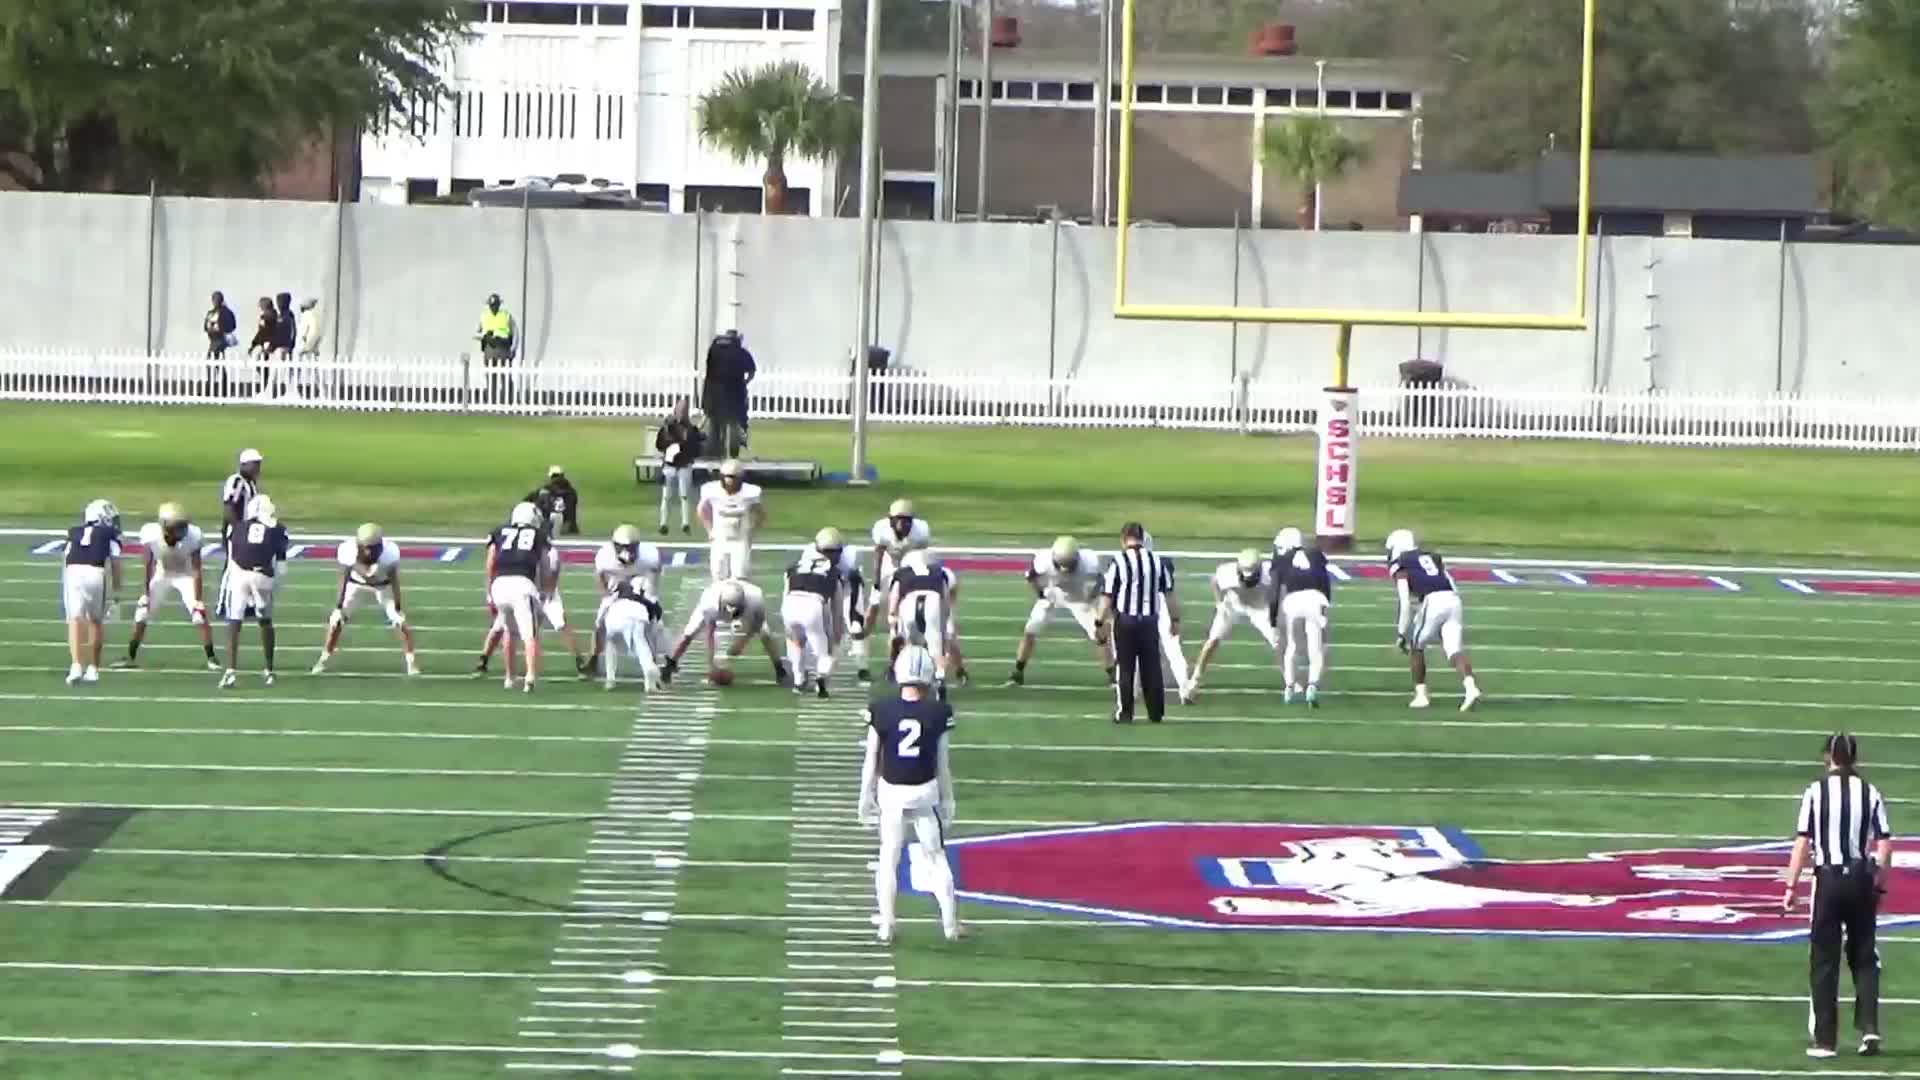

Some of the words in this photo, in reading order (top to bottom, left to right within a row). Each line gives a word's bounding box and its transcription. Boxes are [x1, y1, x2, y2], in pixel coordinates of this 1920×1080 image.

[1325, 419, 1350, 528] SCHSL
[81, 527, 92, 546] 1
[501, 528, 535, 550] 78
[898, 718, 921, 757] 2
